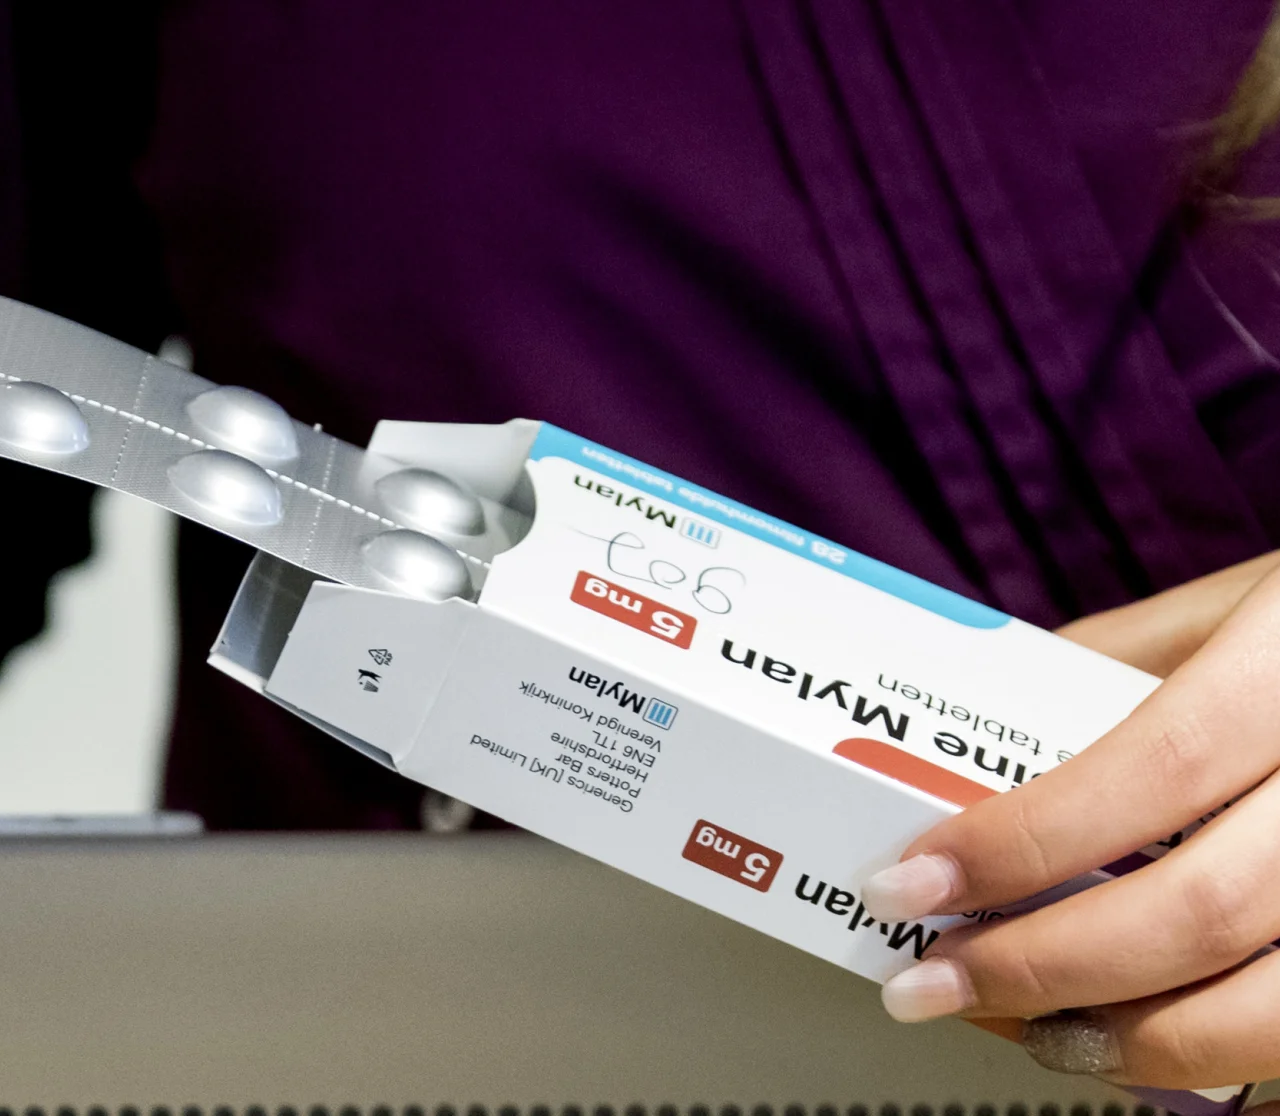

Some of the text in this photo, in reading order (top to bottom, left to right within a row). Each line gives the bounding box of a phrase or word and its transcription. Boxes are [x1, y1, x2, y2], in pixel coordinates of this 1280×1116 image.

[580, 446, 674, 492] tabletten
[573, 474, 677, 529] Mylan
[568, 666, 646, 714] Mylan
[584, 577, 1044, 790] ine Mylan 5 mg
[519, 680, 662, 753] Verenigd Koninkrijk
[877, 673, 1041, 756] tabletten
[469, 733, 634, 813] Generics [UK] Limited
[550, 731, 649, 783] Hertfordshire
[592, 730, 656, 768] EN6 1TL
[554, 751, 642, 798] Potters Bar
[695, 826, 741, 859] mg
[740, 852, 770, 882] 5
